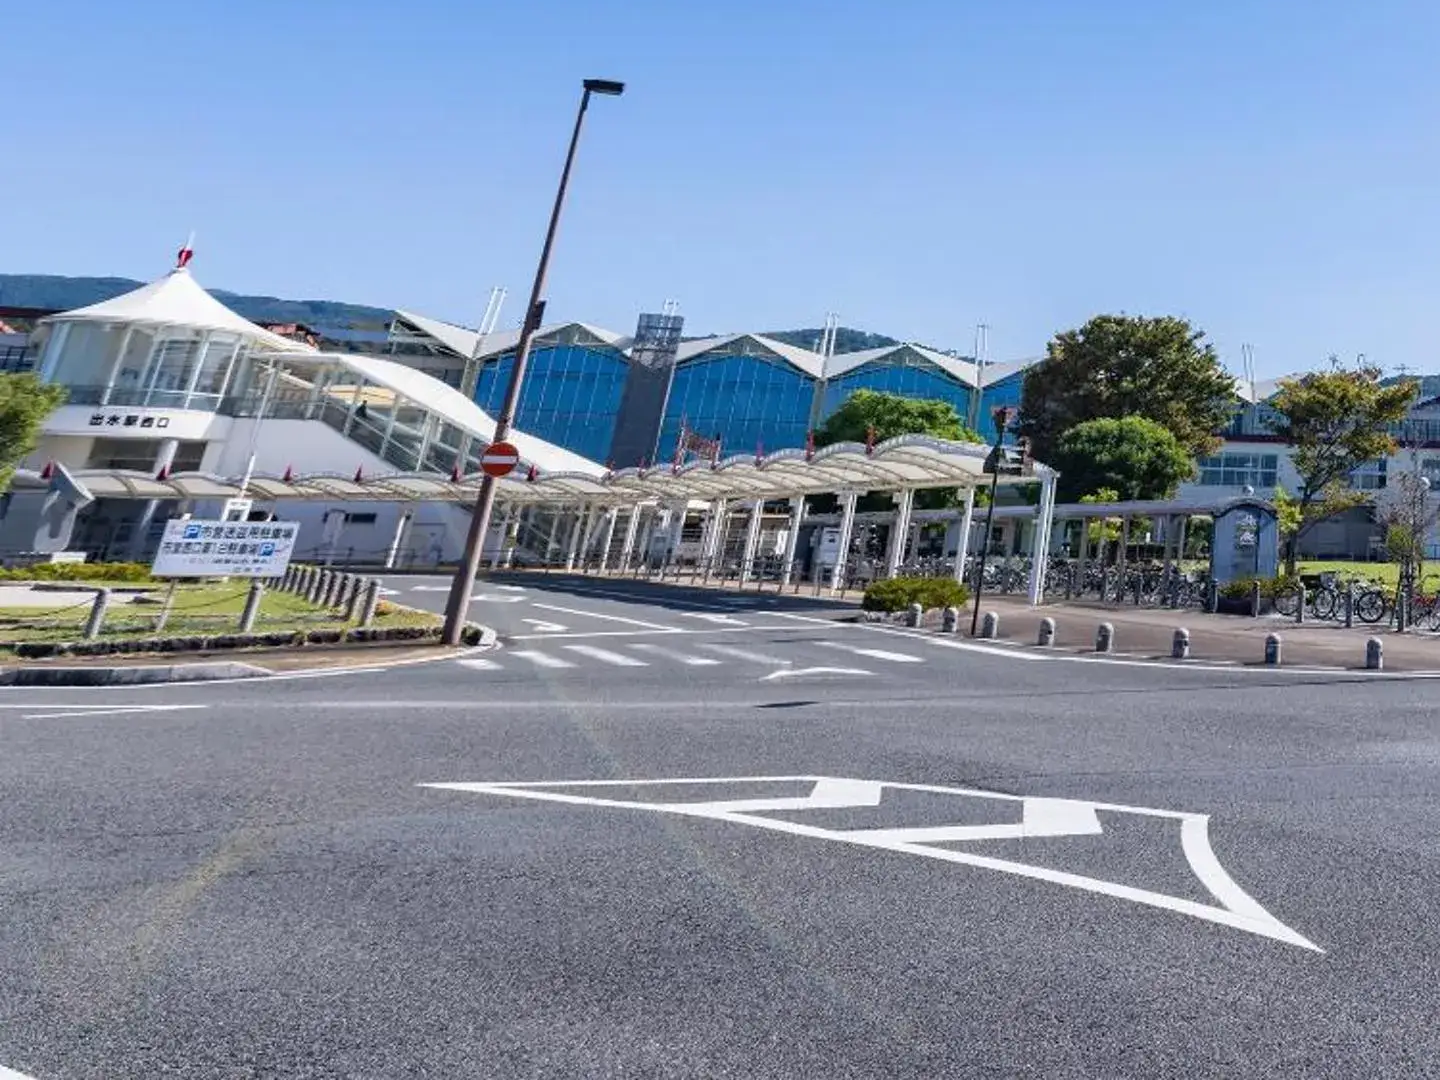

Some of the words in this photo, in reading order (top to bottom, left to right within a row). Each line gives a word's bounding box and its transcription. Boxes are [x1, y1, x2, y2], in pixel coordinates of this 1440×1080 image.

[89, 414, 170, 428] 出水駅西口
